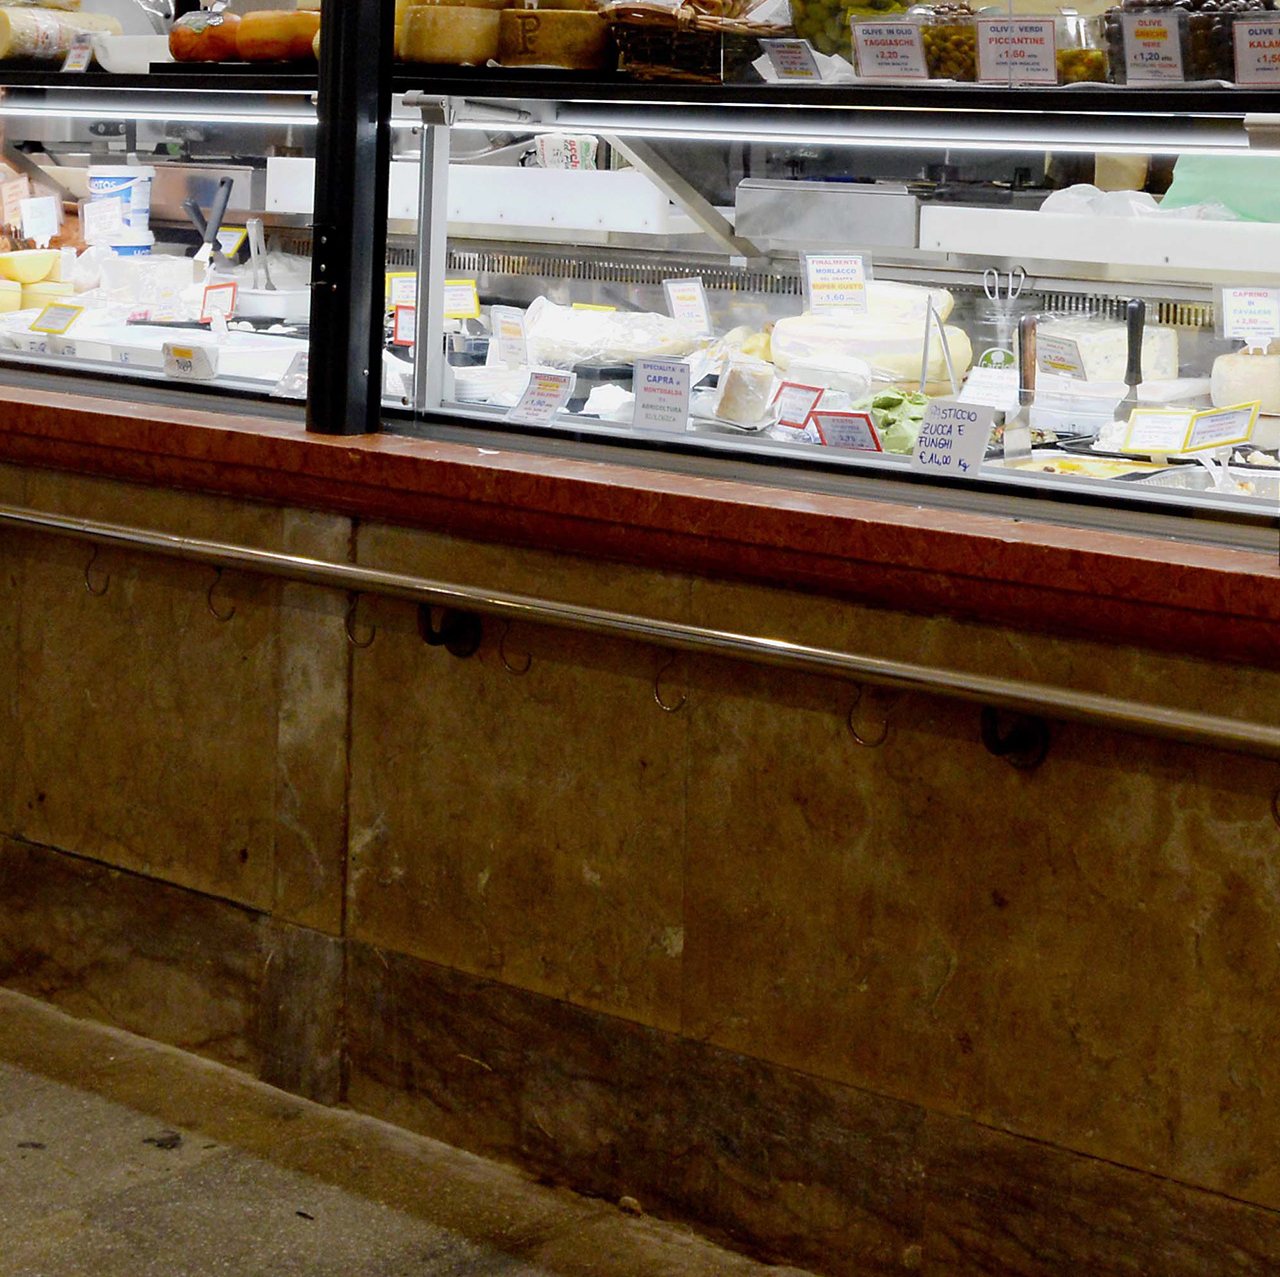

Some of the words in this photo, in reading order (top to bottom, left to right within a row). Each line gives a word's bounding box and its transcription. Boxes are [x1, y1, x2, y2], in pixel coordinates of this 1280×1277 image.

[863, 38, 914, 47] TAGGIASCHE
[989, 37, 1045, 45] PICCANTINE
[880, 50, 898, 60] 2,20
[1140, 52, 1160, 62] 1,20
[535, 375, 567, 383] MOZZARELLA
[647, 375, 674, 385] CAPRA
[642, 403, 682, 413] AGRICOLTURA
[931, 405, 978, 422] PASTICCIO
[922, 424, 953, 436] ZUCCA
[958, 426, 964, 436] E
[918, 436, 953, 449] FUNGHI
